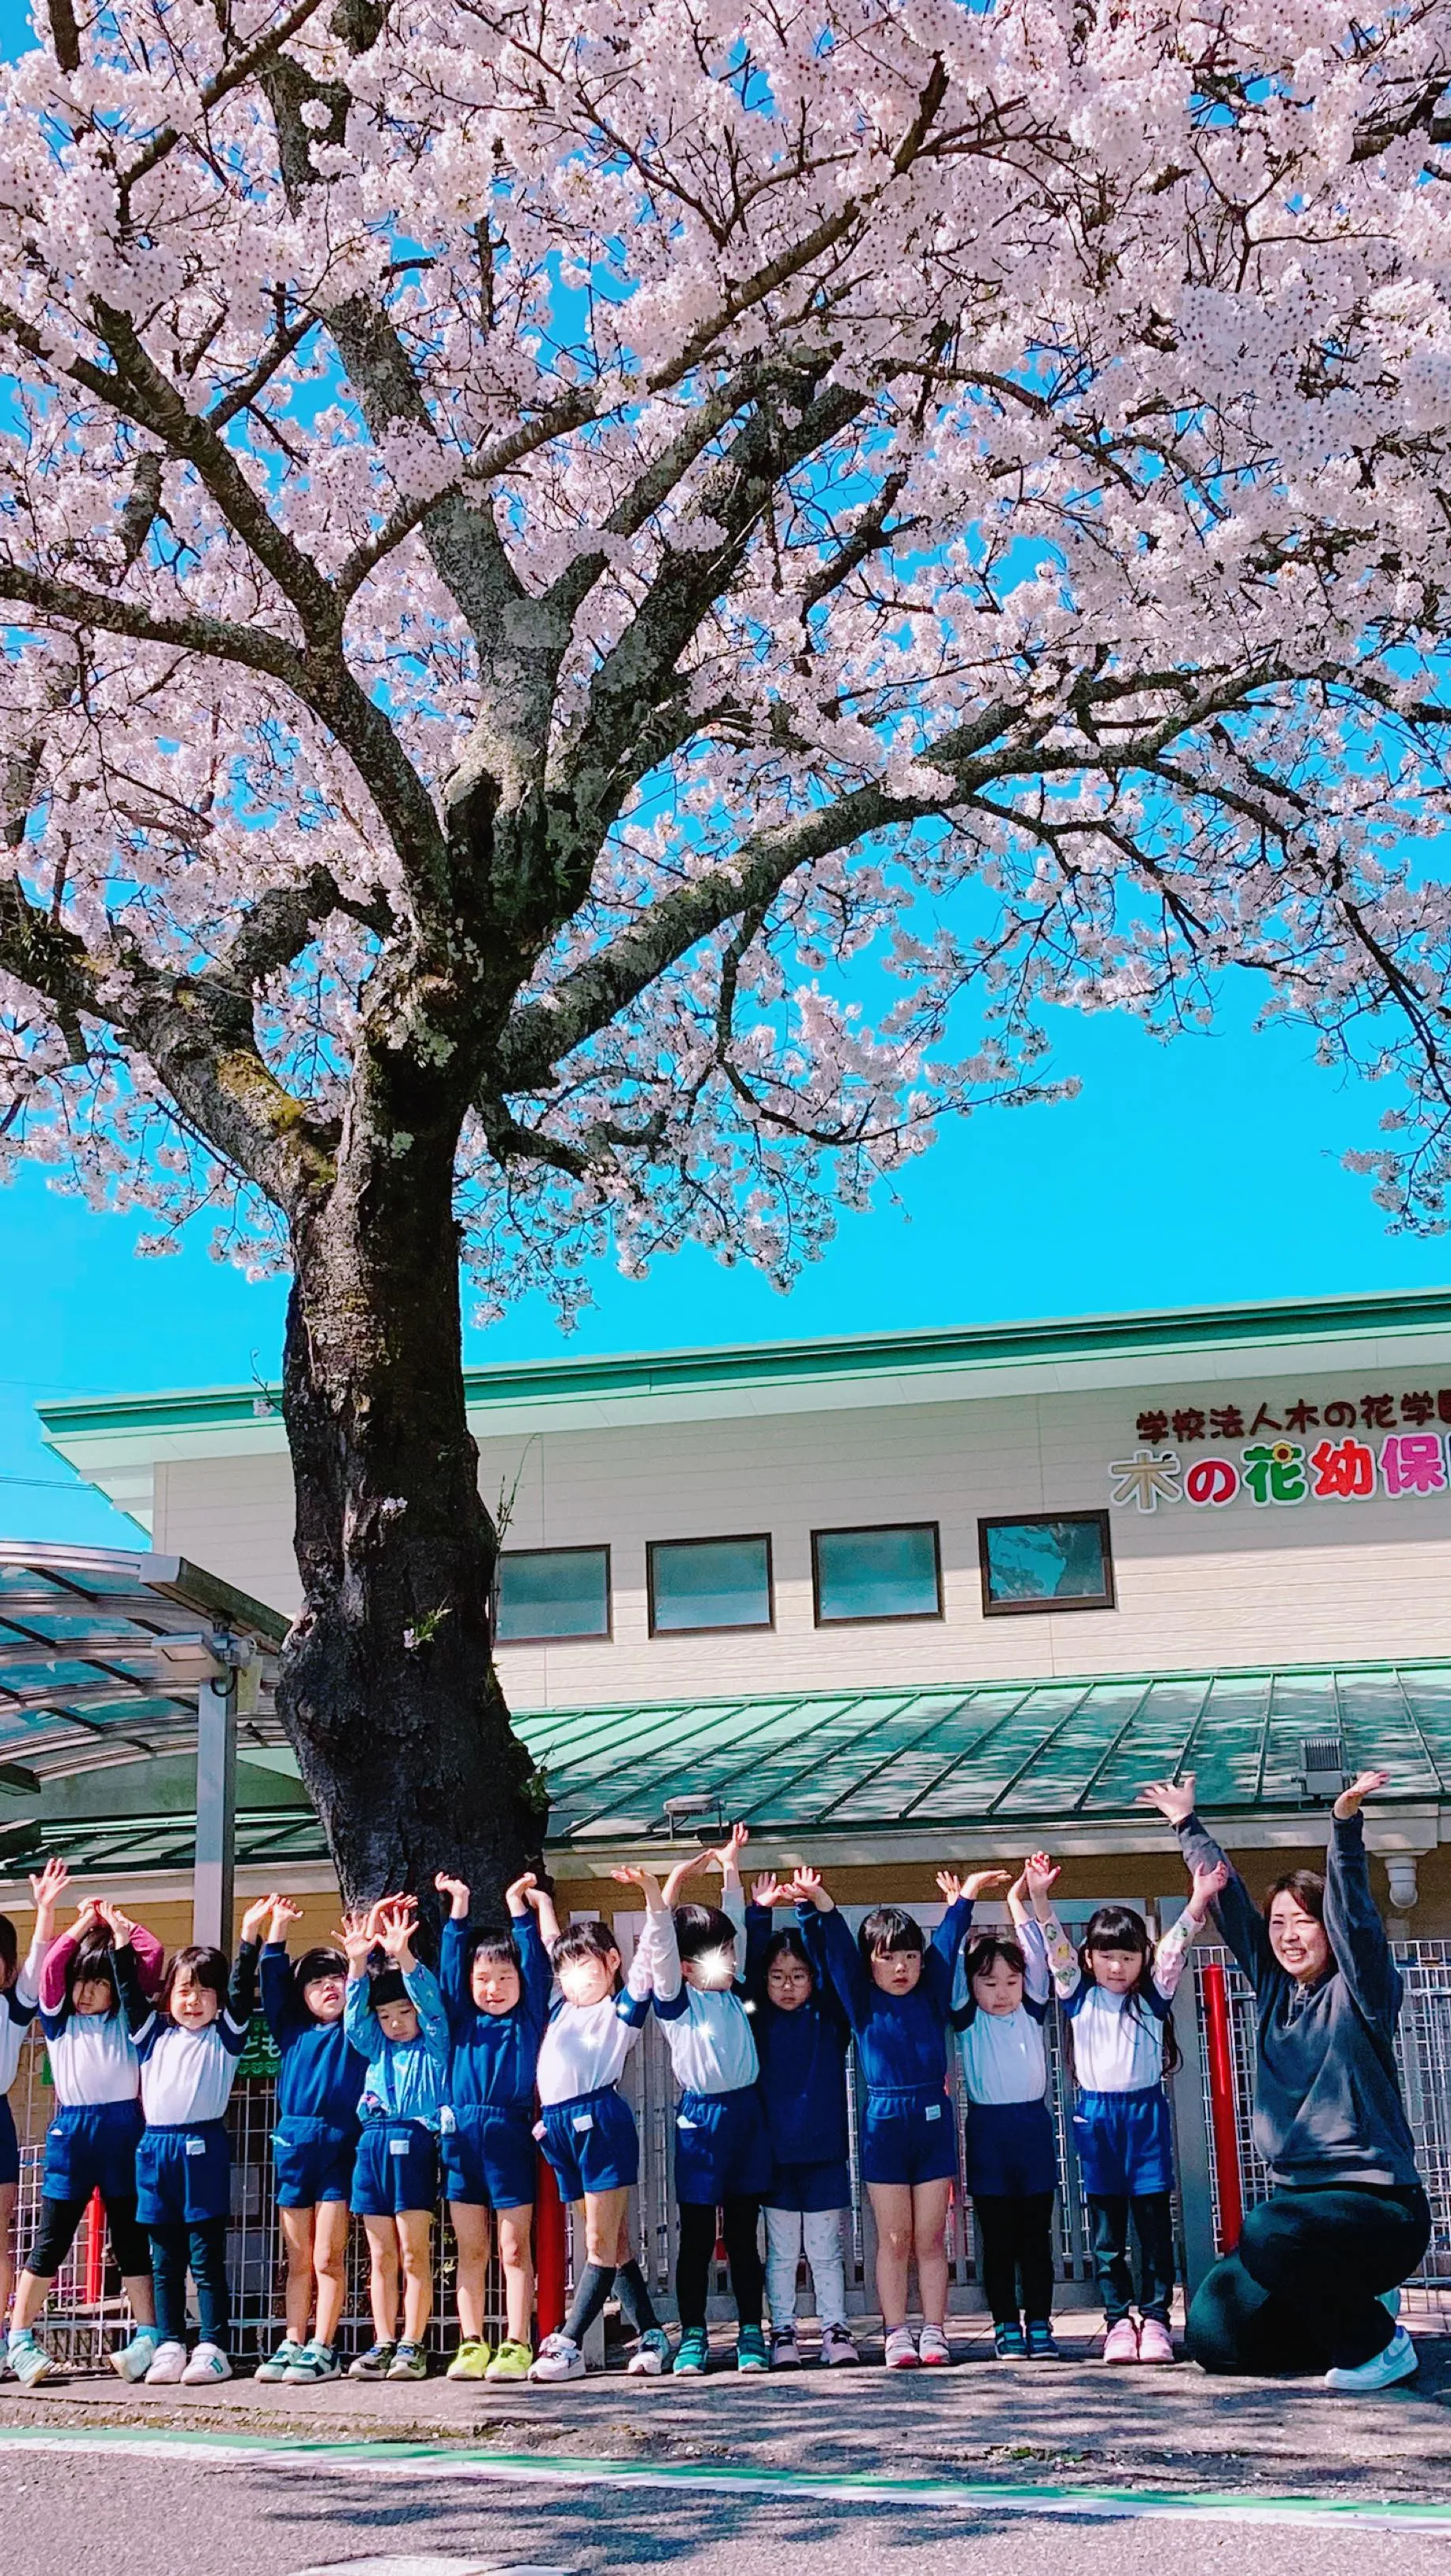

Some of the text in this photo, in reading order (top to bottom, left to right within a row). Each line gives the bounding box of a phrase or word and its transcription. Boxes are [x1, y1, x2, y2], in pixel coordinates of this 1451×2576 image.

[1110, 1433, 1451, 1512] 木の花幼保
